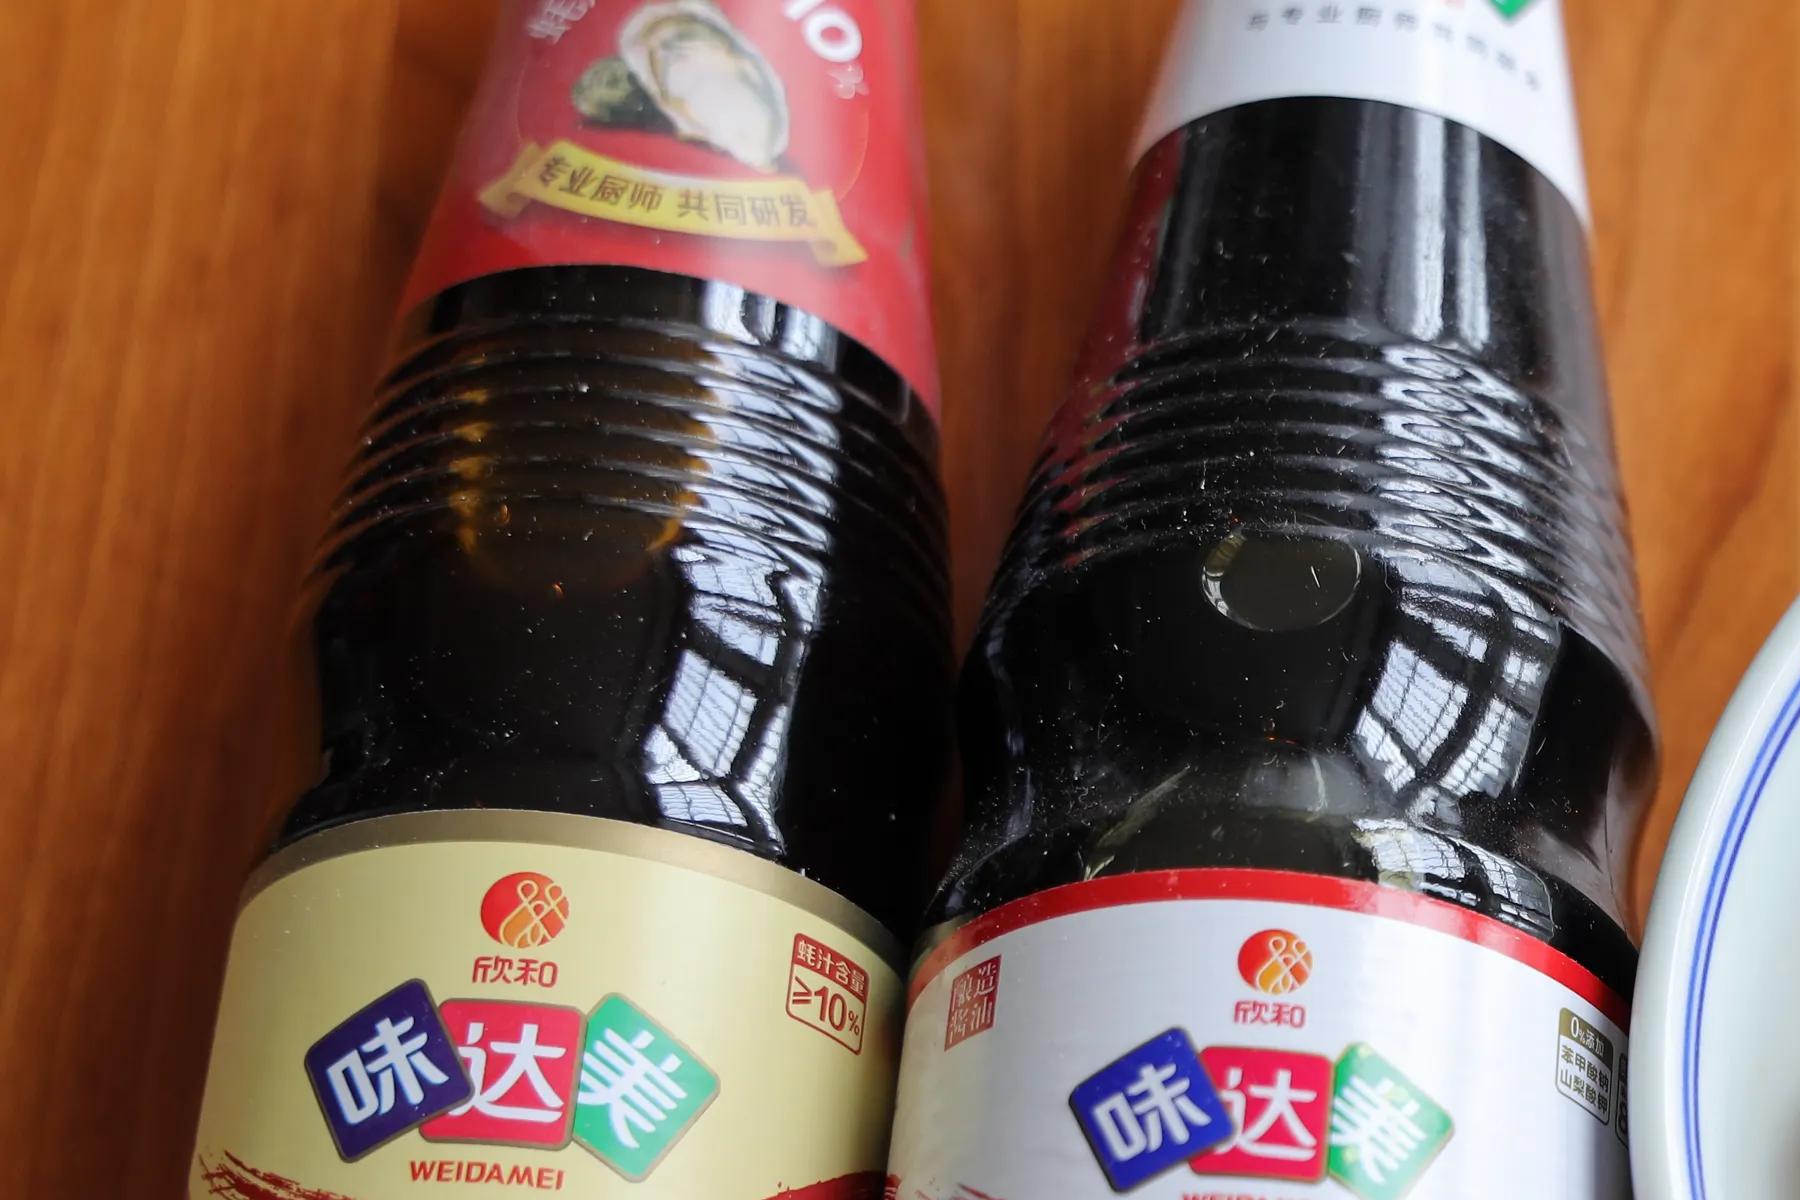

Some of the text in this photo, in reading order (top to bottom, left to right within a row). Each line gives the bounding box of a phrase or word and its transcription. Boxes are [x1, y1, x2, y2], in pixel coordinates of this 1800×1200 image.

[539, 155, 818, 228] 专业厨师 共同研发
[471, 954, 558, 989] 欣和
[797, 940, 866, 997] 蚝汁含量
[1232, 999, 1306, 1030] 欣和
[326, 1014, 688, 1150] 味达美
[1093, 1061, 1428, 1186] 味达美
[409, 1159, 565, 1191] WEIDAMEI
